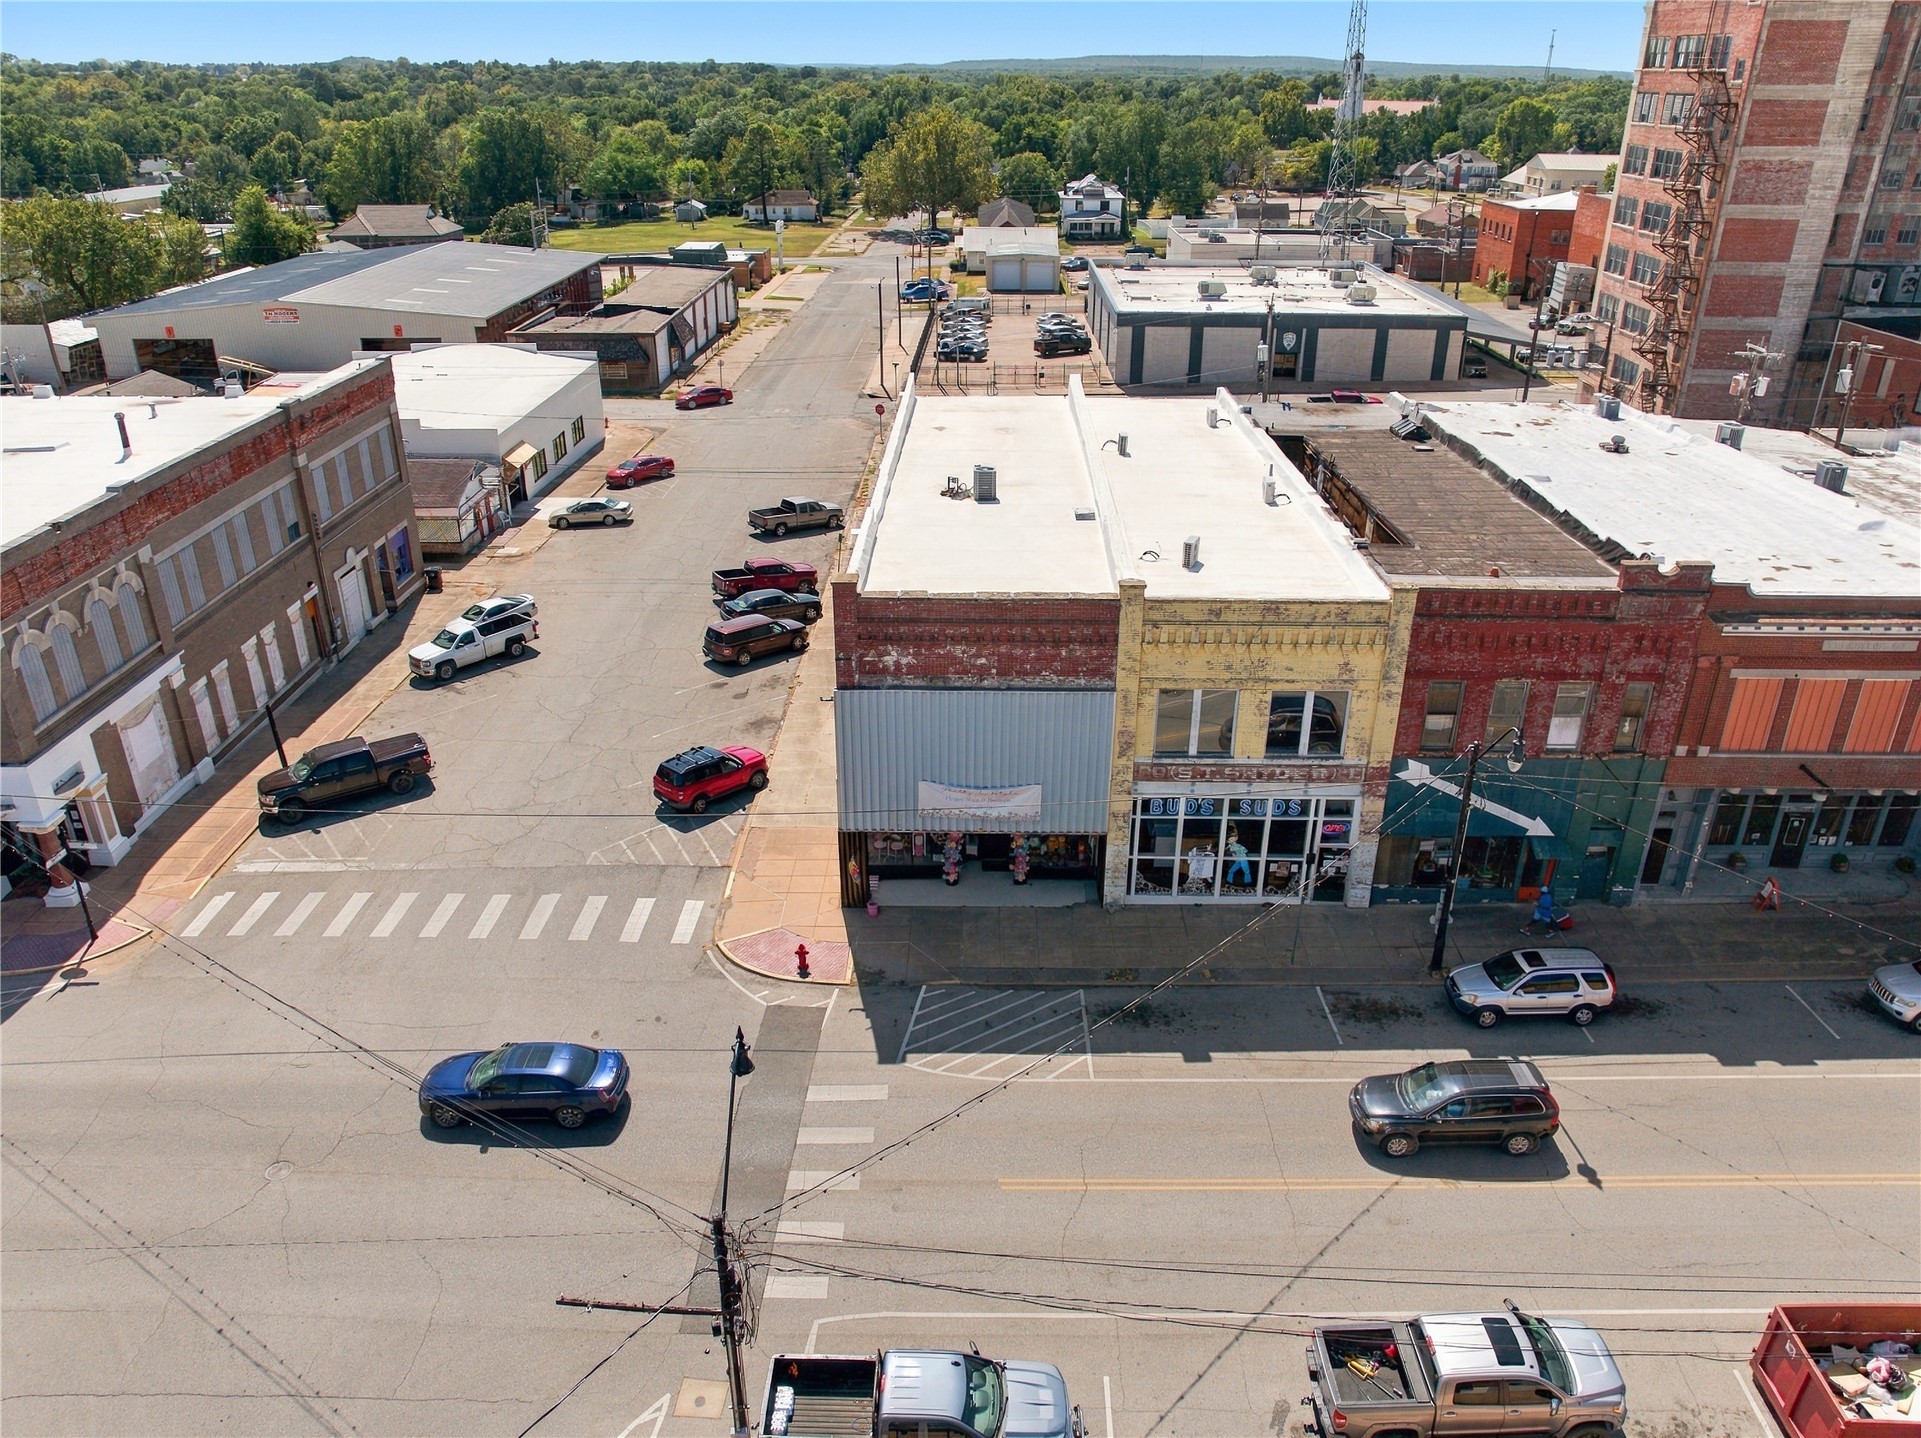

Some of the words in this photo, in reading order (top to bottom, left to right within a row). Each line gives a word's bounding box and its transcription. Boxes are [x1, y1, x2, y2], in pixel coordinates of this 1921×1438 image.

[1150, 798, 1215, 815] BUD'S
[1239, 799, 1301, 816] SUDS
[1324, 824, 1346, 832] OPEN
